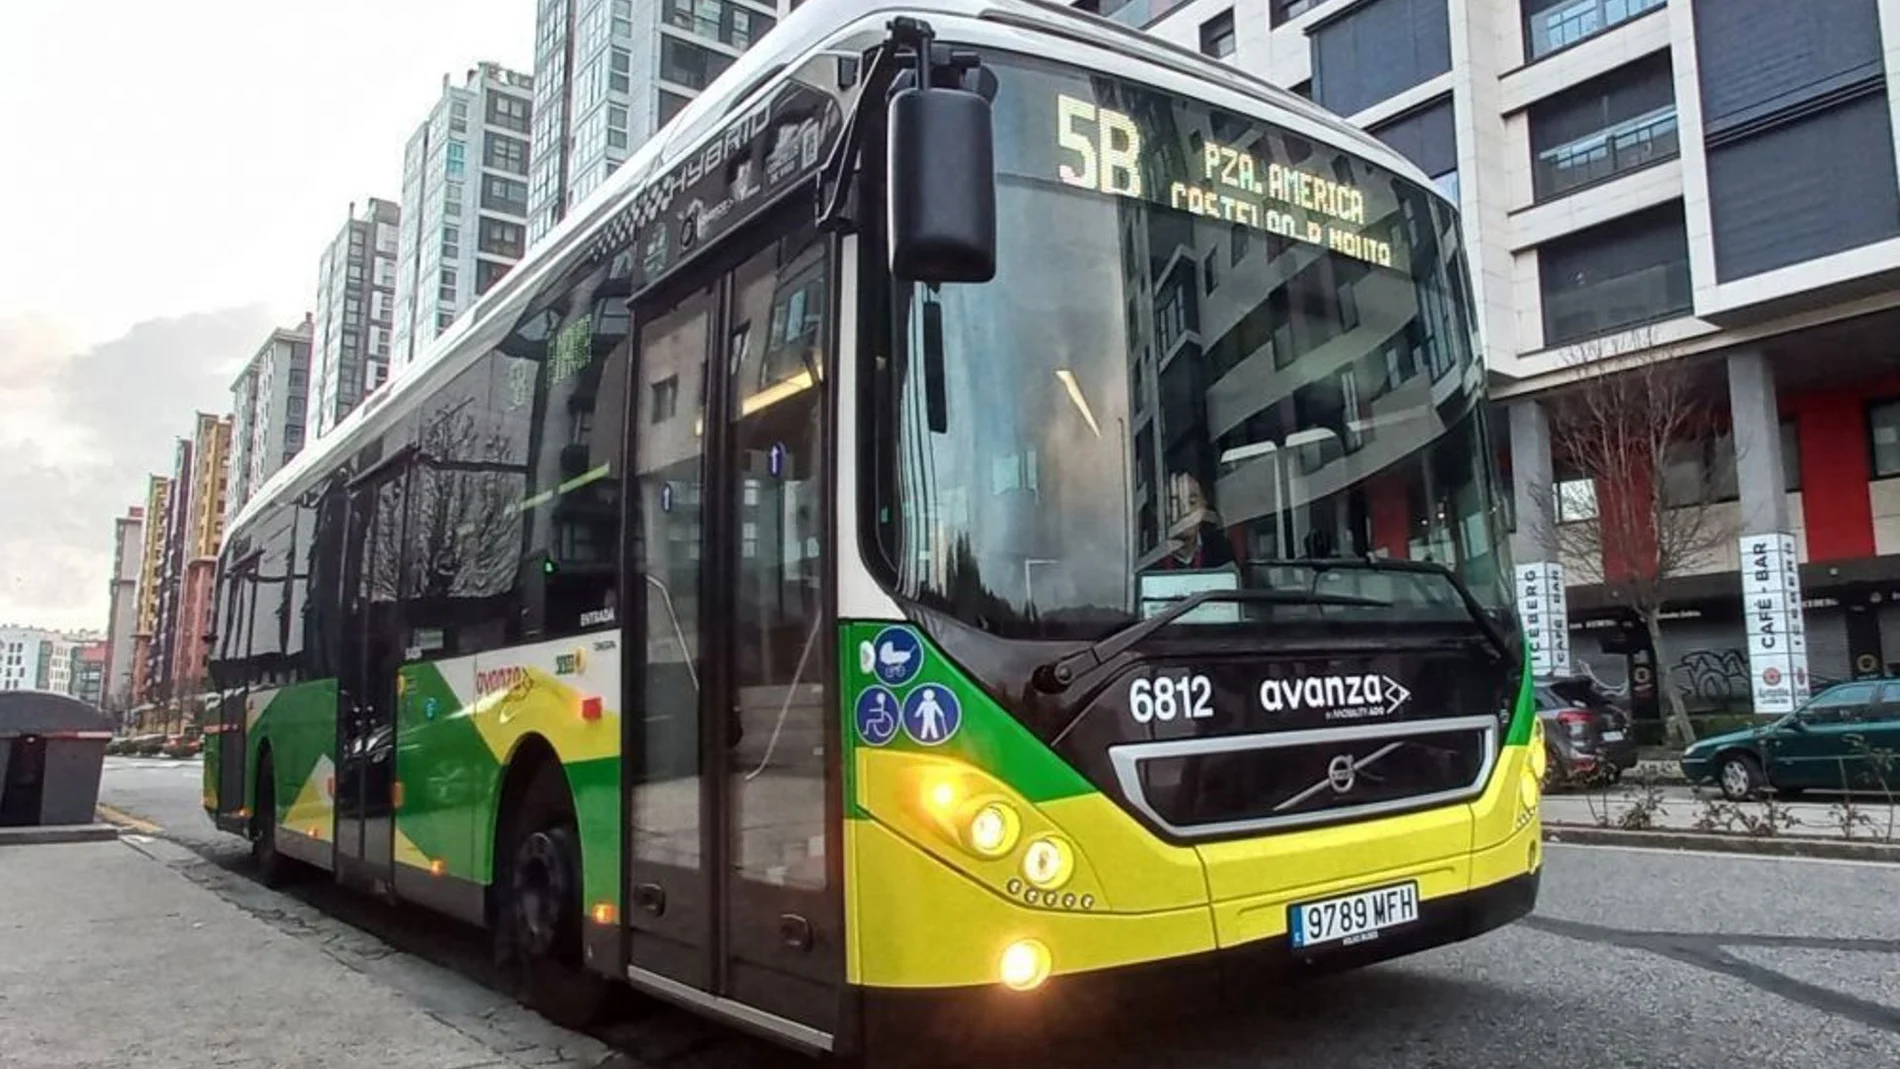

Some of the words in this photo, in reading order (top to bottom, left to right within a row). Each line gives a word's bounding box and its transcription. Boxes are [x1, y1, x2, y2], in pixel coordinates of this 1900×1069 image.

[1057, 95, 1141, 197] 5B
[1204, 142, 1263, 194] PZA.
[1268, 163, 1364, 225] AMERICA
[1753, 543, 1770, 581] BAR
[1524, 570, 1542, 661] ICEBERG
[1130, 675, 1214, 723] 6812
[1260, 674, 1384, 712] avanza
[1308, 898, 1367, 939] 9789
[1373, 887, 1414, 926] MFH
